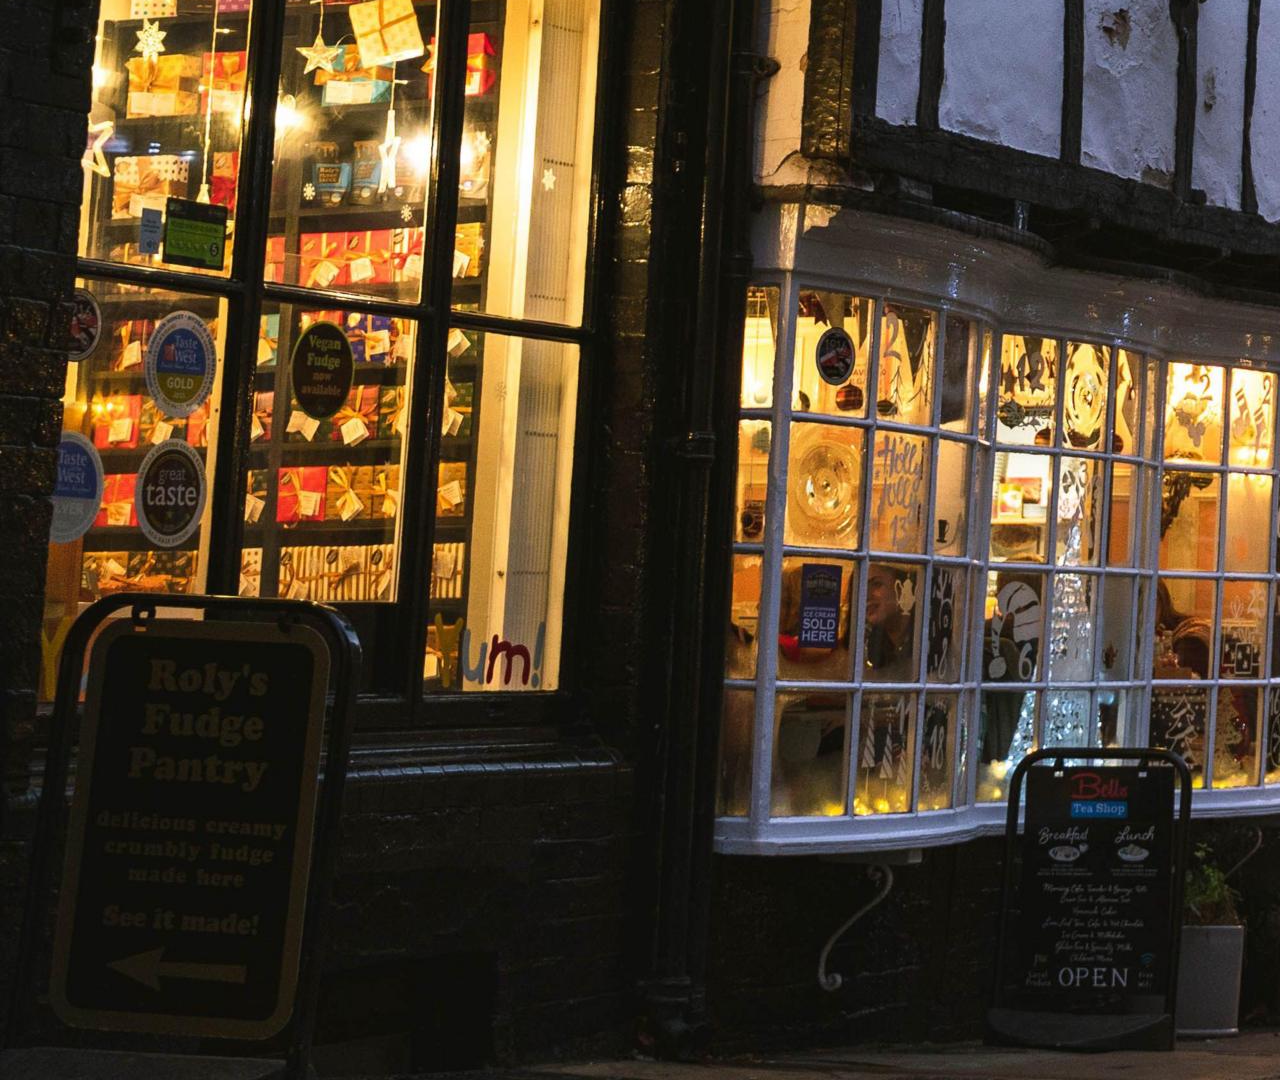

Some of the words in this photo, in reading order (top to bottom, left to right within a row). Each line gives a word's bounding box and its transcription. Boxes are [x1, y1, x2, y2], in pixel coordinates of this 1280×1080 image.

[309, 335, 341, 351] Vegan
[307, 353, 341, 370] Fudge
[167, 377, 194, 389] GOLD
[159, 469, 186, 483] great
[146, 484, 197, 507] taste
[802, 619, 836, 630] SOLD
[802, 630, 835, 643] HERE
[148, 659, 271, 701] Roly's
[142, 703, 265, 747] Fudge
[128, 745, 270, 792] Pantry
[1074, 803, 1093, 813] Tea
[1096, 802, 1126, 816] Shop
[97, 810, 197, 833] delicious
[206, 819, 287, 840] creamy
[1115, 825, 1156, 844] Lunch
[104, 840, 201, 862] crumbly
[208, 842, 274, 866] fudge
[128, 866, 188, 884] made
[196, 869, 245, 887] here
[102, 904, 146, 928] See
[153, 907, 176, 930] it
[181, 913, 260, 936] made!
[1058, 967, 1128, 988] OPEN
